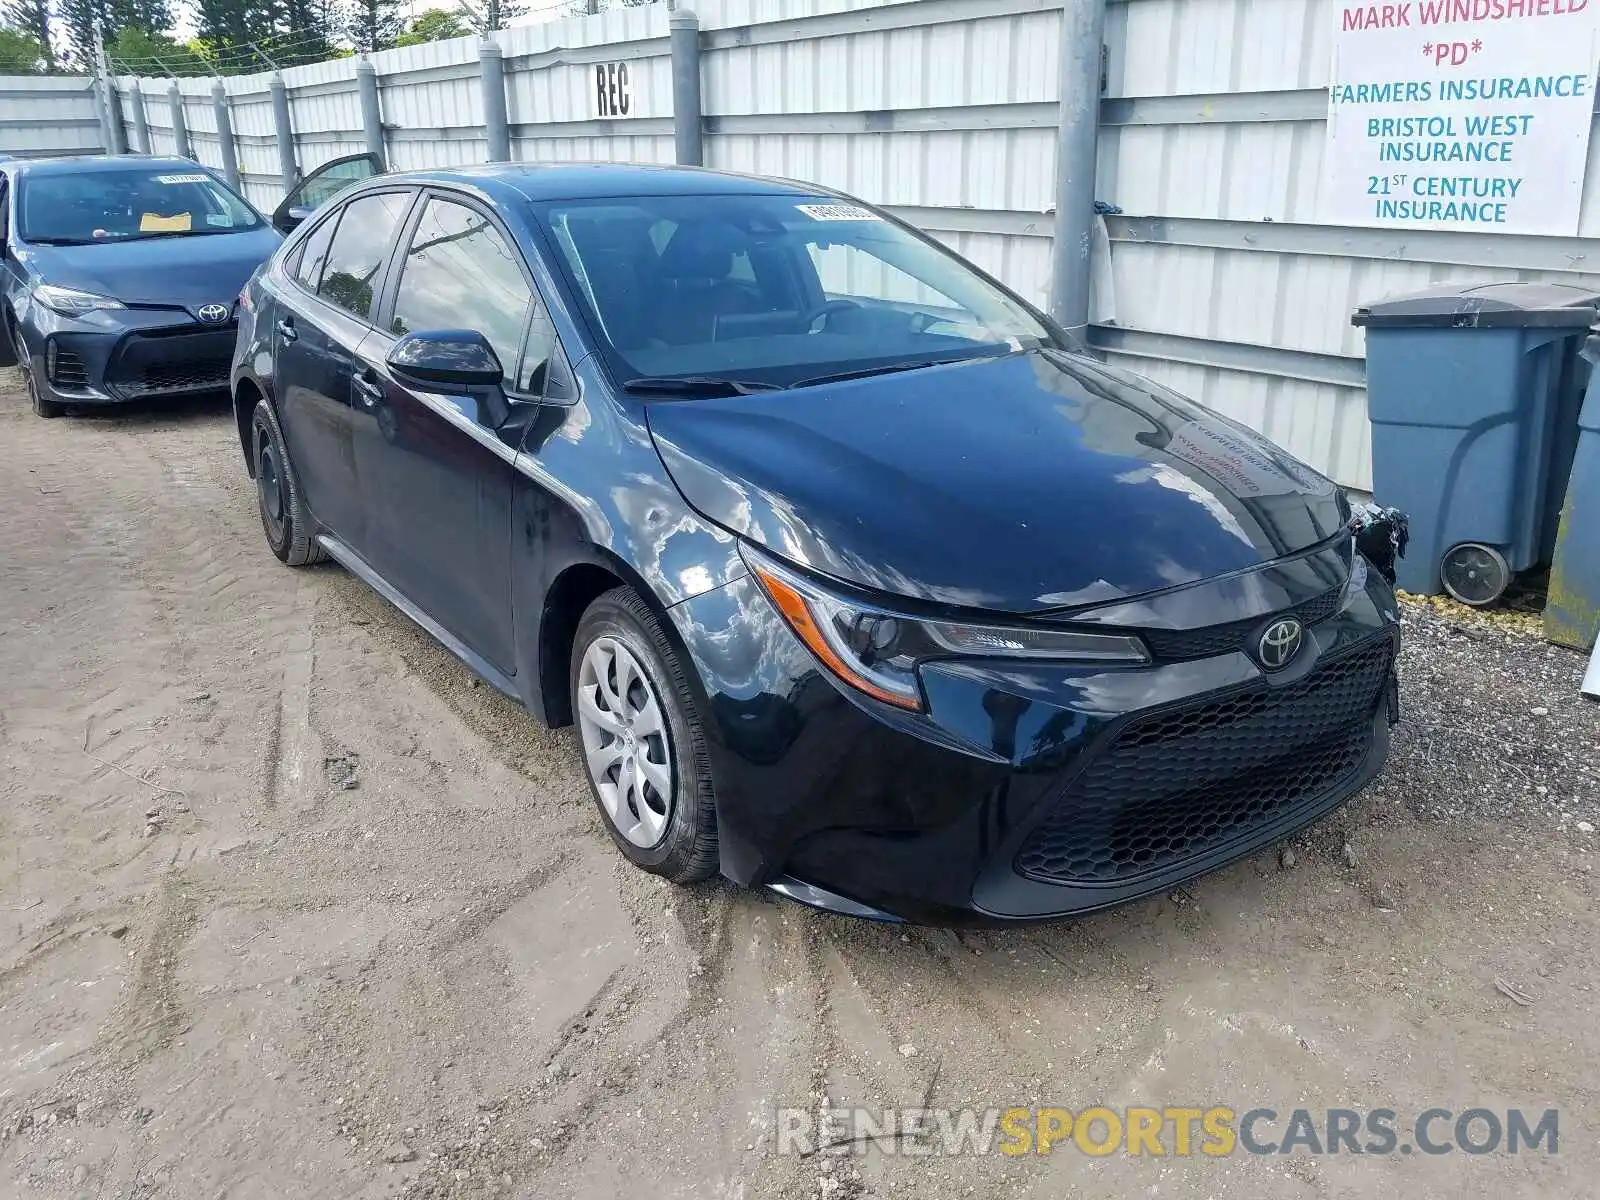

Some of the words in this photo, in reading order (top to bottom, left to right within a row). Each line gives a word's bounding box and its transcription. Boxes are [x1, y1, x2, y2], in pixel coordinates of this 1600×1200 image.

[1342, 3, 1411, 31] MARK
[1419, 0, 1588, 26] WINDSHIELD
[596, 62, 629, 116] REC
[1331, 81, 1432, 105] FARMERS
[1439, 75, 1588, 101] INSURANCE
[1367, 117, 1457, 138] BRISTOL
[1465, 115, 1534, 136] WEST
[1379, 141, 1513, 162] INSURANCE
[1413, 177, 1523, 198] CENTURY
[1375, 200, 1508, 223] INSURANCE
